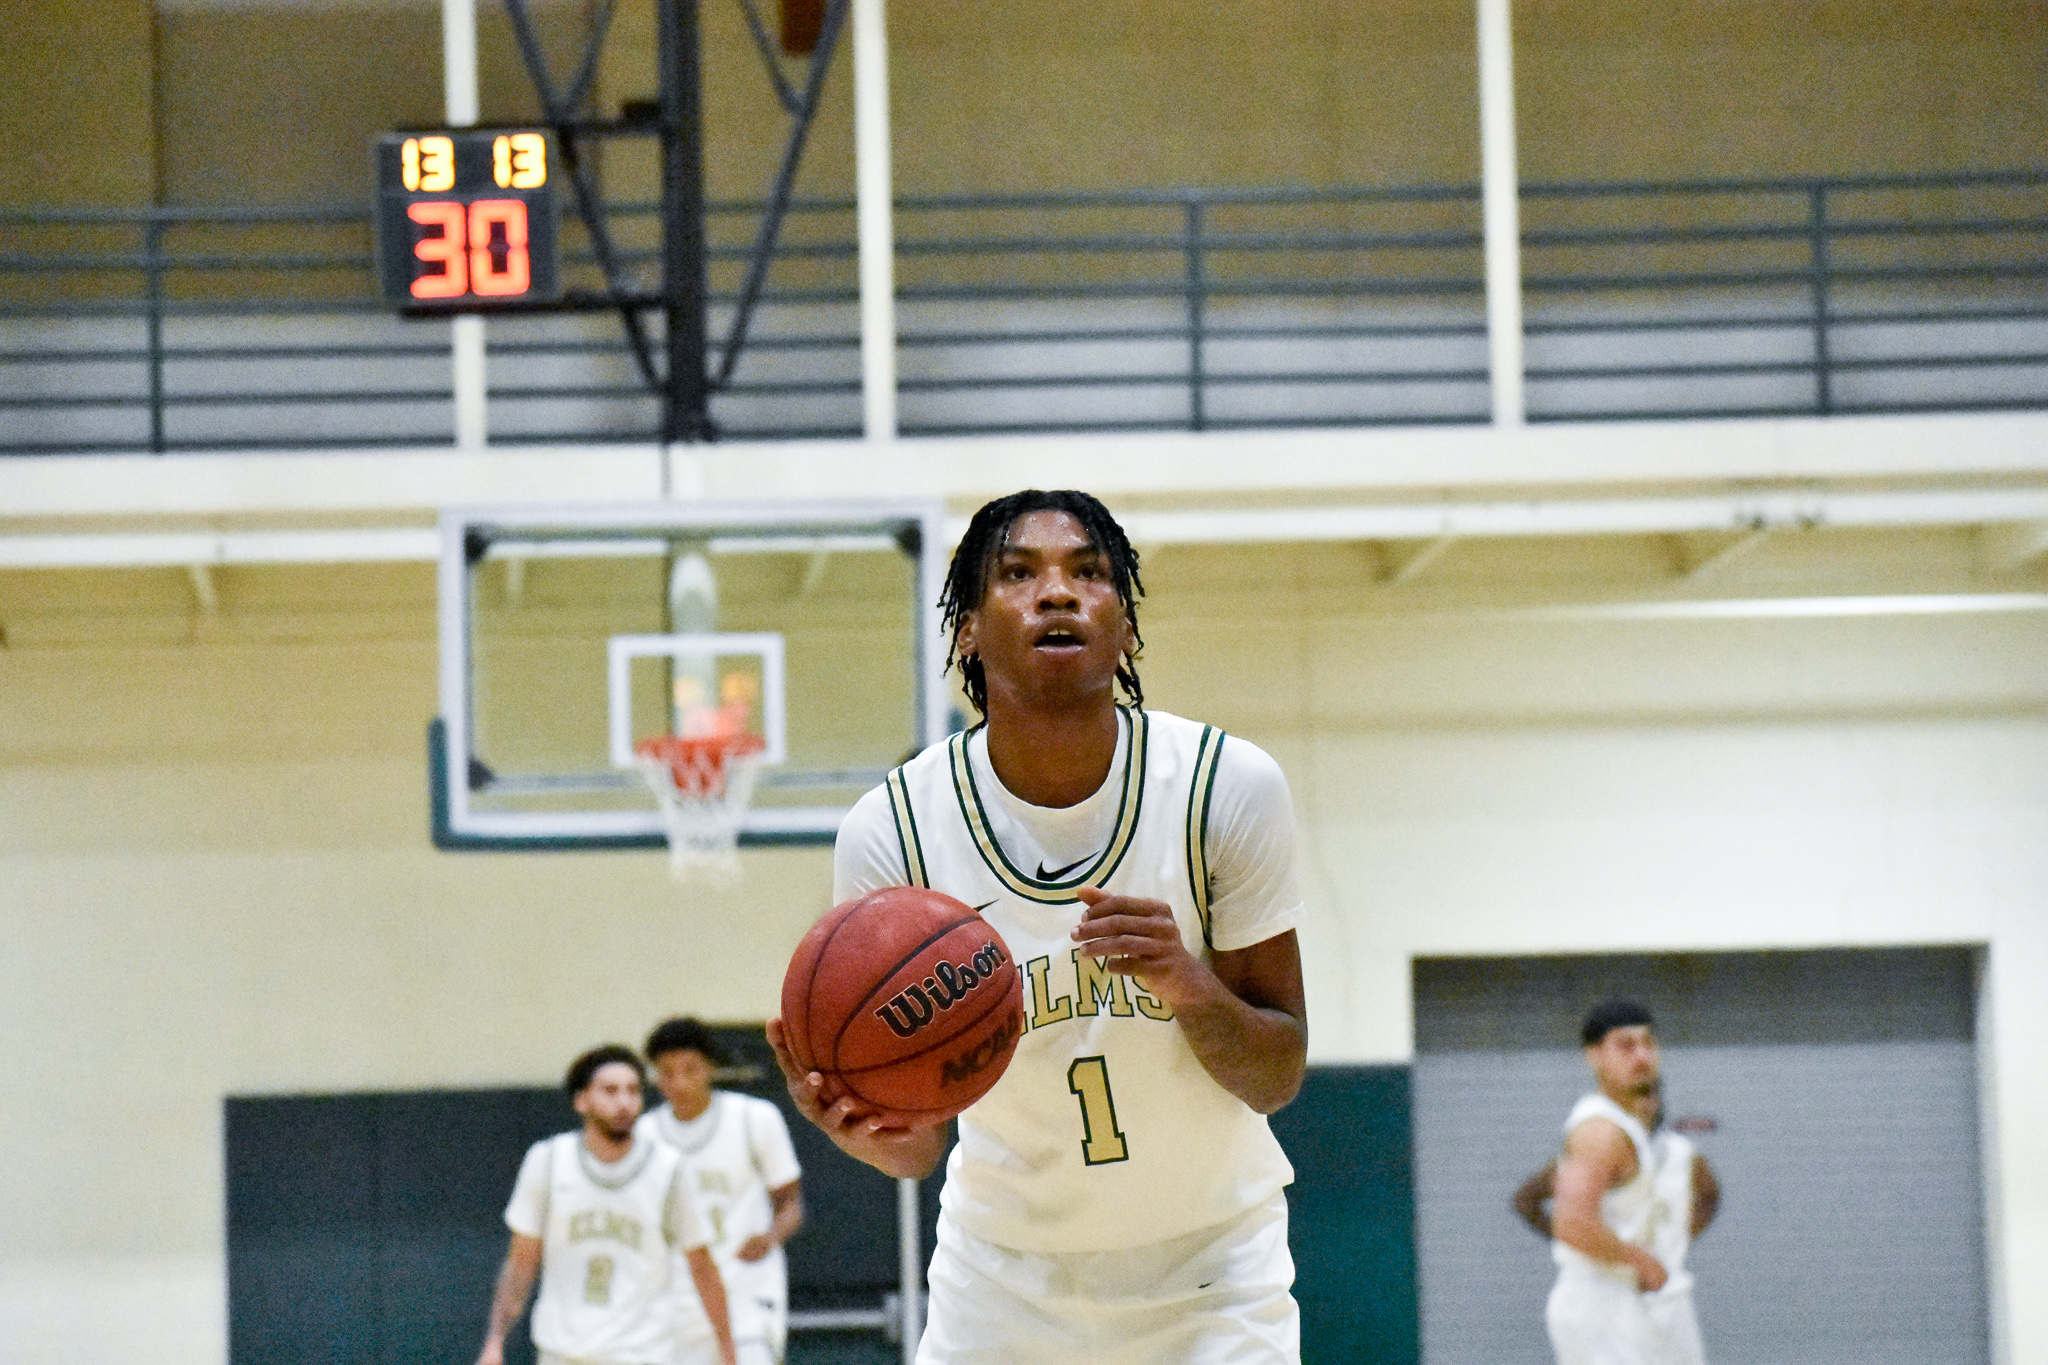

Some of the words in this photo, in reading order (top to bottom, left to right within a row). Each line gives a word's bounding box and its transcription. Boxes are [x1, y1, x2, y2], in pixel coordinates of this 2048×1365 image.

[401, 136, 456, 192] 13
[493, 133, 547, 189] 13
[407, 199, 531, 299] 30
[873, 938, 1008, 1039] Wilson
[1015, 946, 1175, 1037] LMS
[1066, 1054, 1130, 1167] 1
